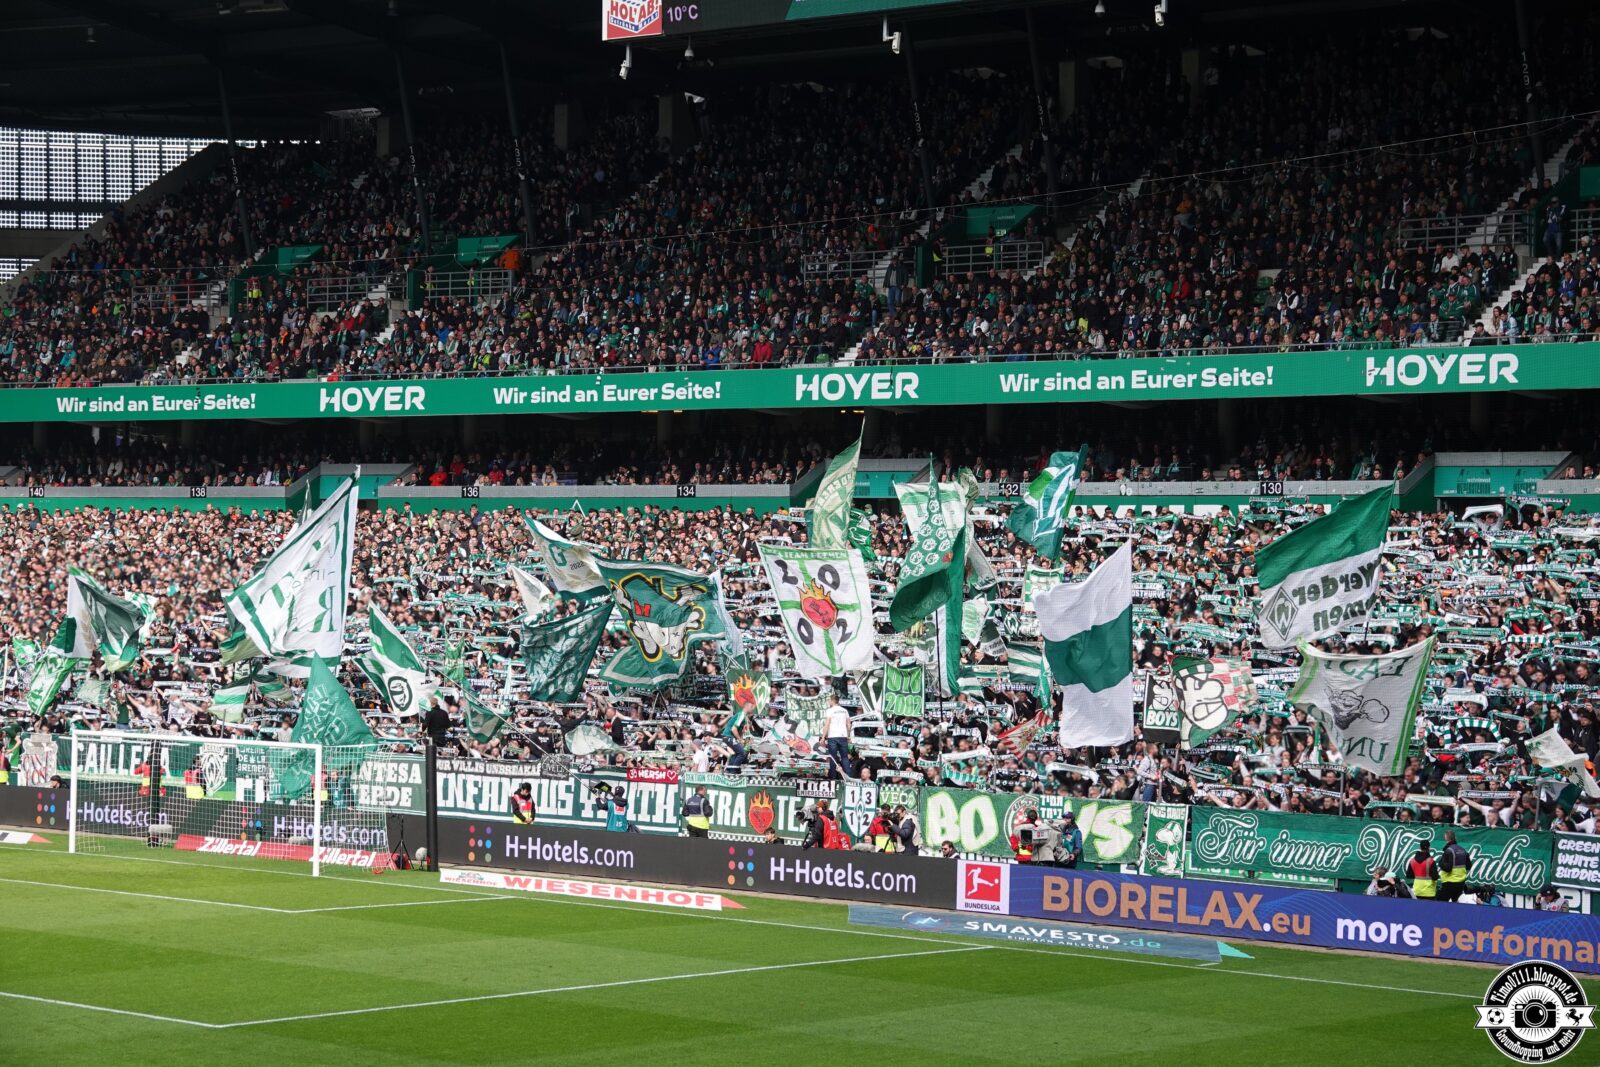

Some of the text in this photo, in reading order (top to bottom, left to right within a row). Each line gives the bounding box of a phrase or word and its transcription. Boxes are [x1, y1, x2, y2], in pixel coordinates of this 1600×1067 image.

[667, 4, 698, 22] 10°C
[1000, 366, 1274, 393] Wir sind an Eurer Seite!
[1367, 353, 1519, 386] HOYER
[493, 381, 721, 405] Wir sind an Eurer Seite!
[795, 371, 919, 401] HOYER
[56, 393, 256, 413] Wir sind an Eurer Seite!
[320, 386, 425, 412] HOYER
[29, 487, 44, 497] 140
[190, 487, 206, 497] 138
[462, 487, 478, 497] 136
[678, 486, 694, 497] 134
[1001, 484, 1018, 496] 132
[1261, 481, 1282, 495] 130
[775, 559, 841, 590] 2 0
[797, 617, 852, 645] 0 2
[885, 692, 923, 716] 2002
[1146, 710, 1179, 727] BOYS
[638, 770, 666, 780] HERSH
[865, 791, 872, 805] 3
[862, 813, 870, 827] 2
[196, 837, 262, 857] Zillertal
[505, 834, 634, 869] H-Hotels.com
[1197, 813, 1267, 866] Für
[1269, 830, 1352, 872] immer
[1557, 852, 1599, 868] WHITE
[770, 857, 917, 894] H-Hotels.com
[503, 875, 715, 908] WIESENHOF
[964, 902, 1001, 912] BUNDESLIGA
[1043, 875, 1311, 937] BIORELAX.eu
[964, 921, 1161, 949] SMAVESTO.de
[1336, 917, 1423, 948] more
[1433, 925, 1600, 964] performa
